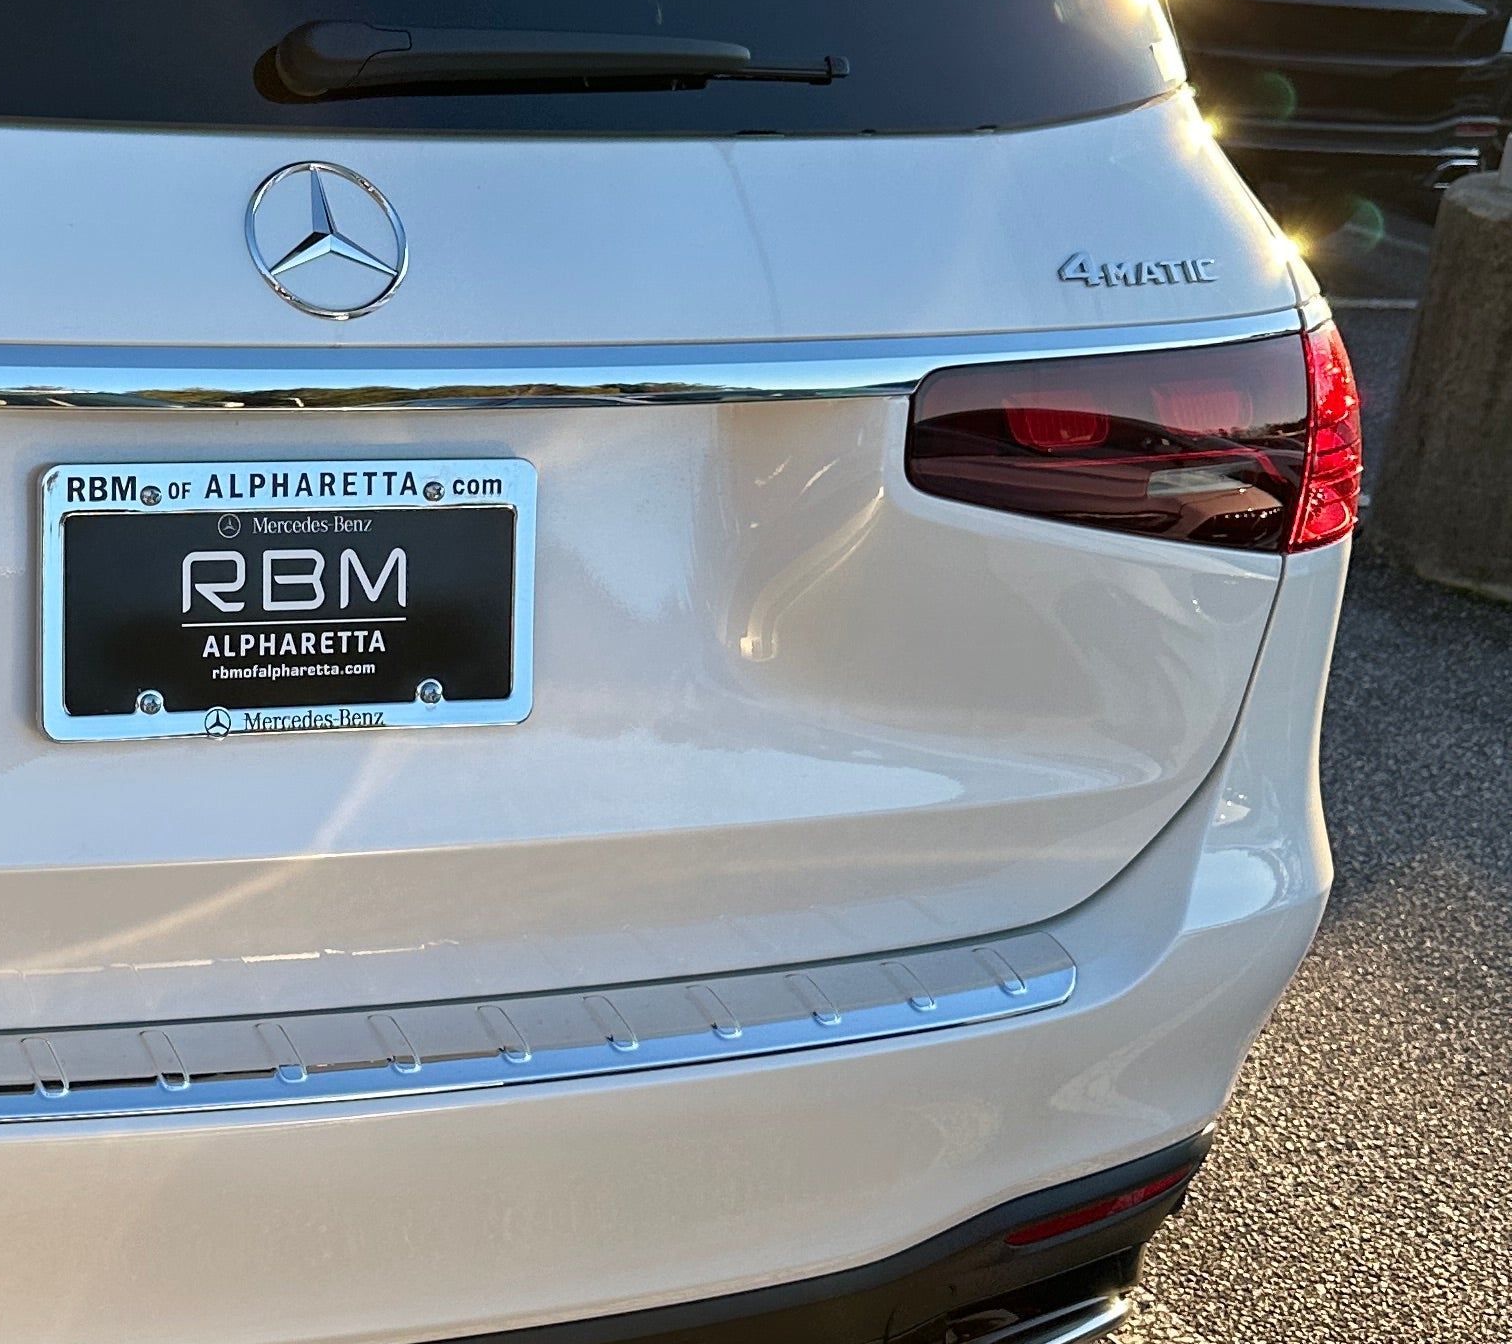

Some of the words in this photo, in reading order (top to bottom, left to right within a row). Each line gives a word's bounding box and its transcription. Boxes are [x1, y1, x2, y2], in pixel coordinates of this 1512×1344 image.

[1058, 251, 1219, 287] 4MATIC
[67, 476, 137, 502] RBM
[168, 482, 192, 500] OF
[204, 471, 418, 499] ALPHARETTA
[252, 515, 373, 534] Mercedes-Benz
[182, 547, 406, 613] RBM
[202, 630, 386, 657] ALPHARETTA
[212, 663, 376, 680] rbmofalpharetta.com
[244, 708, 385, 731] Mercedes-Benz
